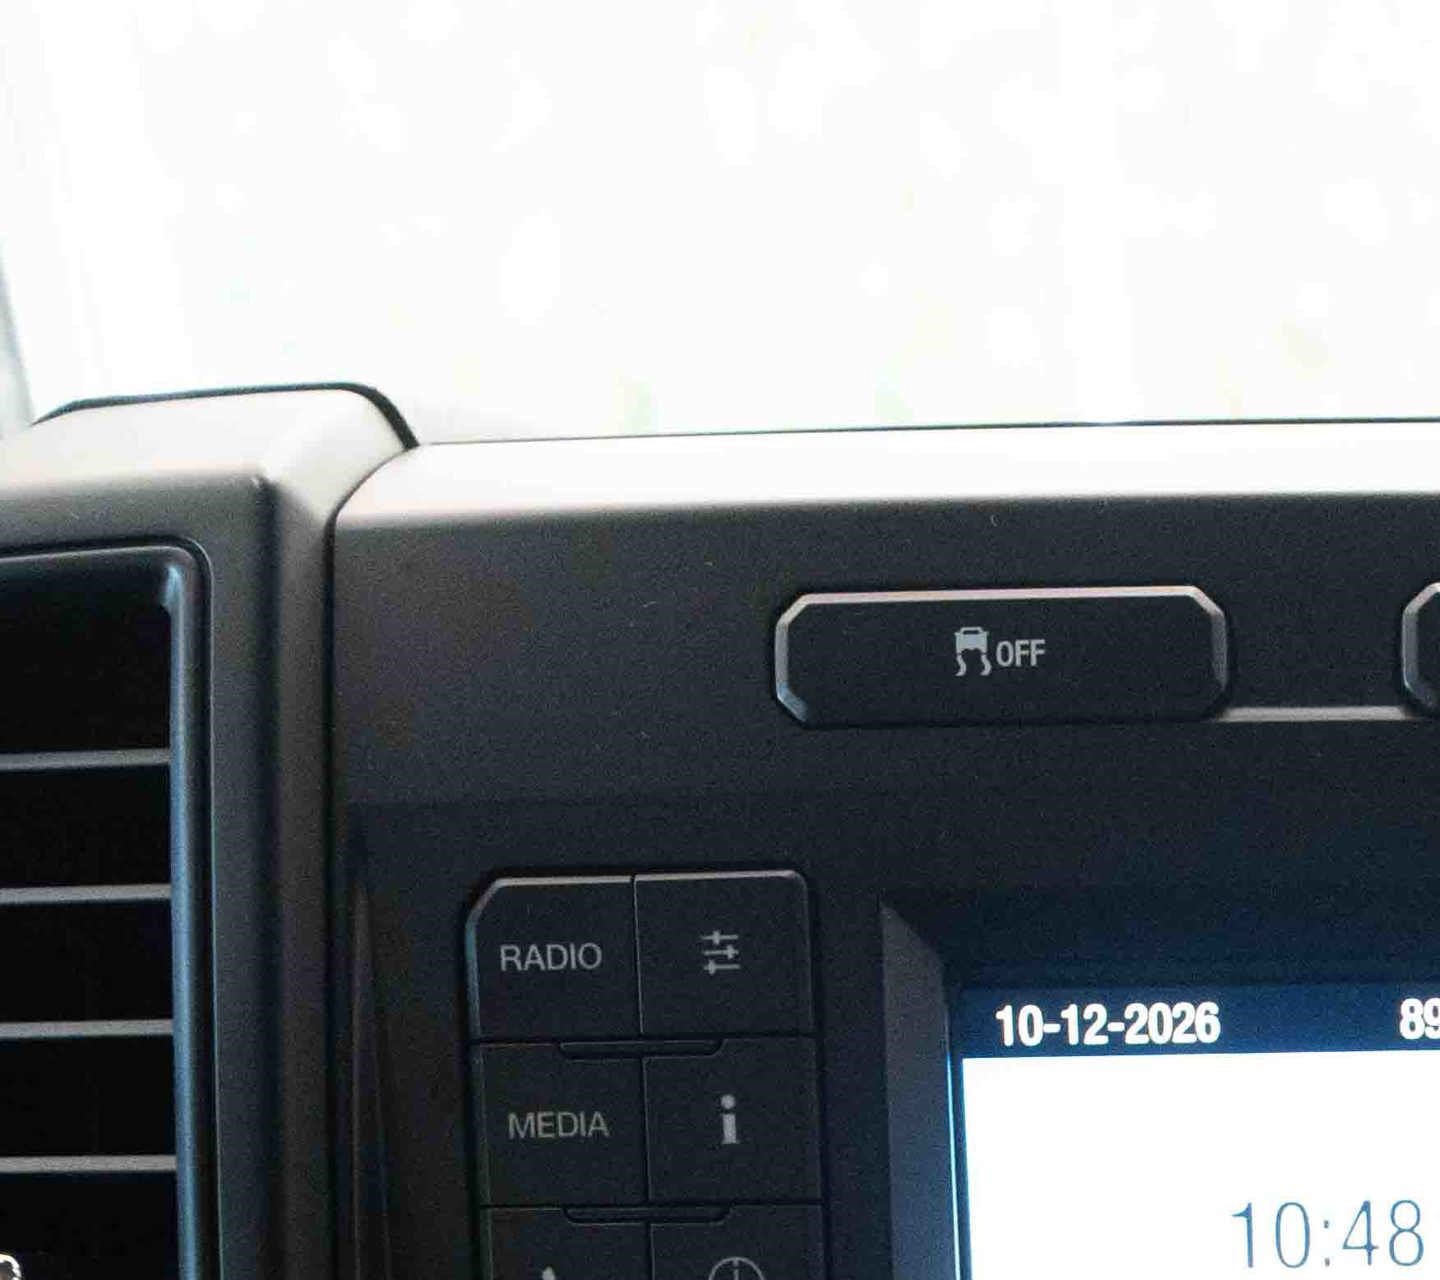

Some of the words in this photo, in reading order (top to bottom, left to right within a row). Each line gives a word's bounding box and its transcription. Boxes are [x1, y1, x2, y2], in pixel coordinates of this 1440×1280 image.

[995, 638, 1046, 667] OFF
[499, 942, 602, 972] RADIO
[995, 1001, 1222, 1047] 10-12-2026
[507, 1111, 610, 1139] MEDIA
[1231, 1199, 1425, 1269] 10:48
